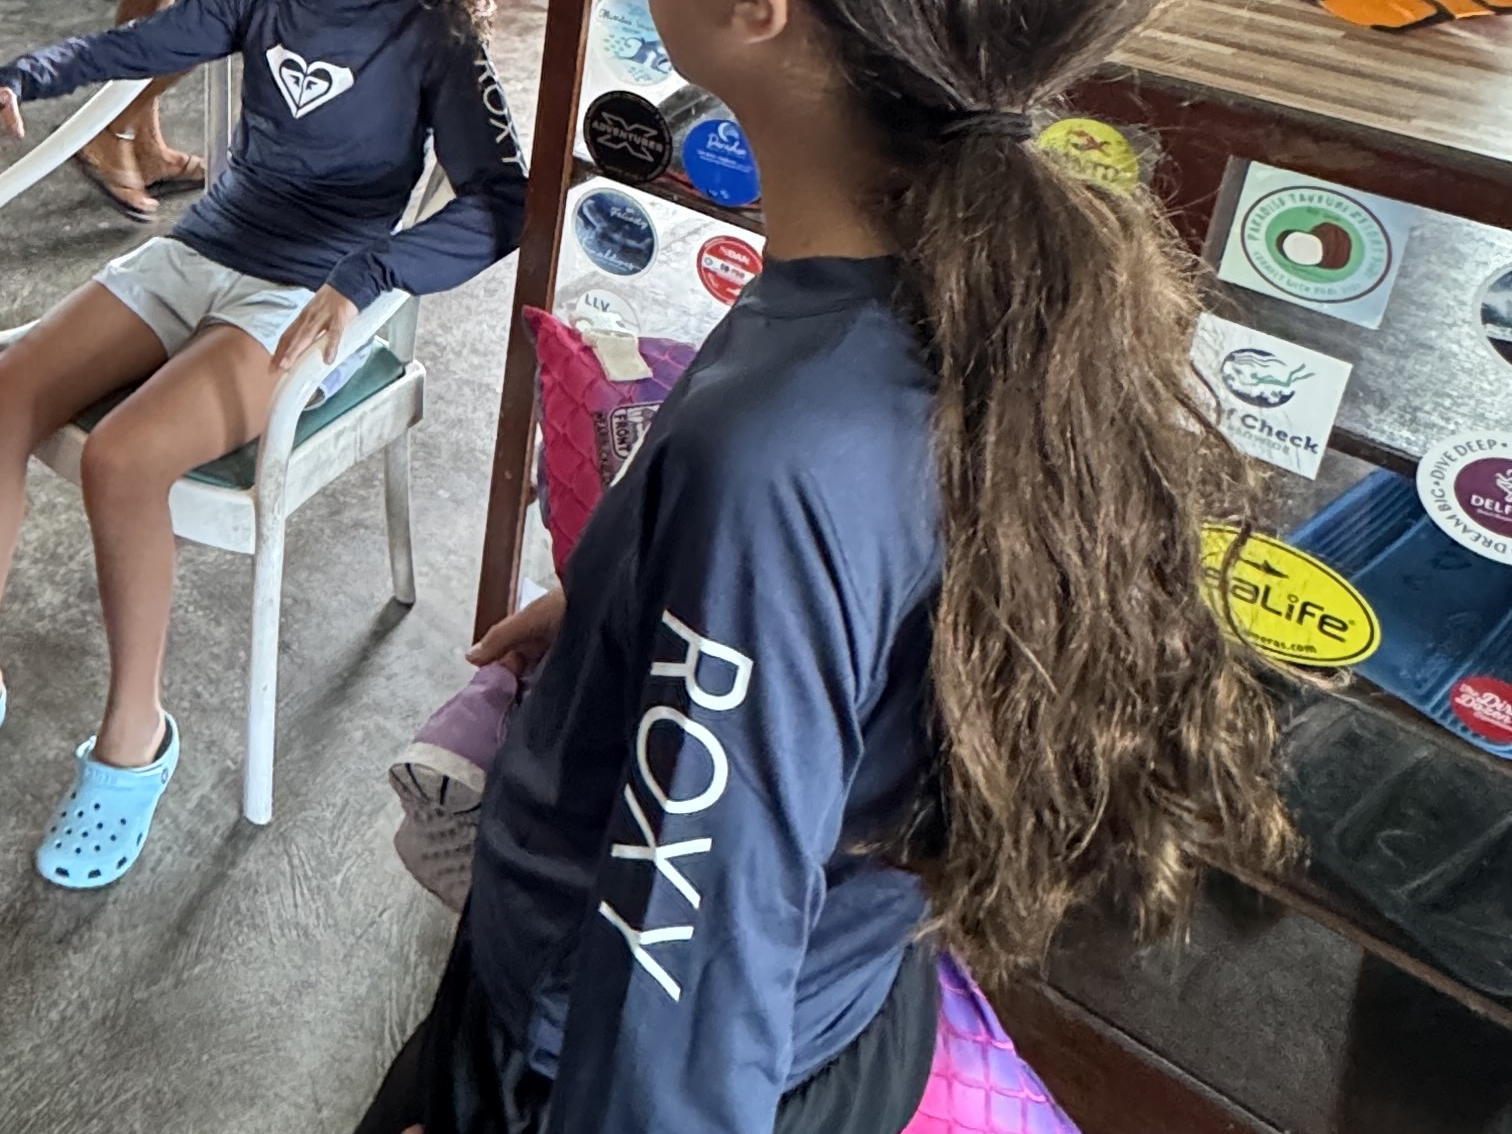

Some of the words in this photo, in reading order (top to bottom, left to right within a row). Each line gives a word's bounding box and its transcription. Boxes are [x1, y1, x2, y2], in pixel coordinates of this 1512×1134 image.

[613, 414, 631, 453] FRONT
[1240, 413, 1320, 455] Check
[1452, 438, 1498, 457] DEEP
[1429, 450, 1459, 481] DIVE
[1430, 487, 1453, 513] BIG
[1445, 513, 1508, 555] DREAM
[1202, 566, 1350, 644] eaLife
[599, 608, 754, 1002] ROXY
